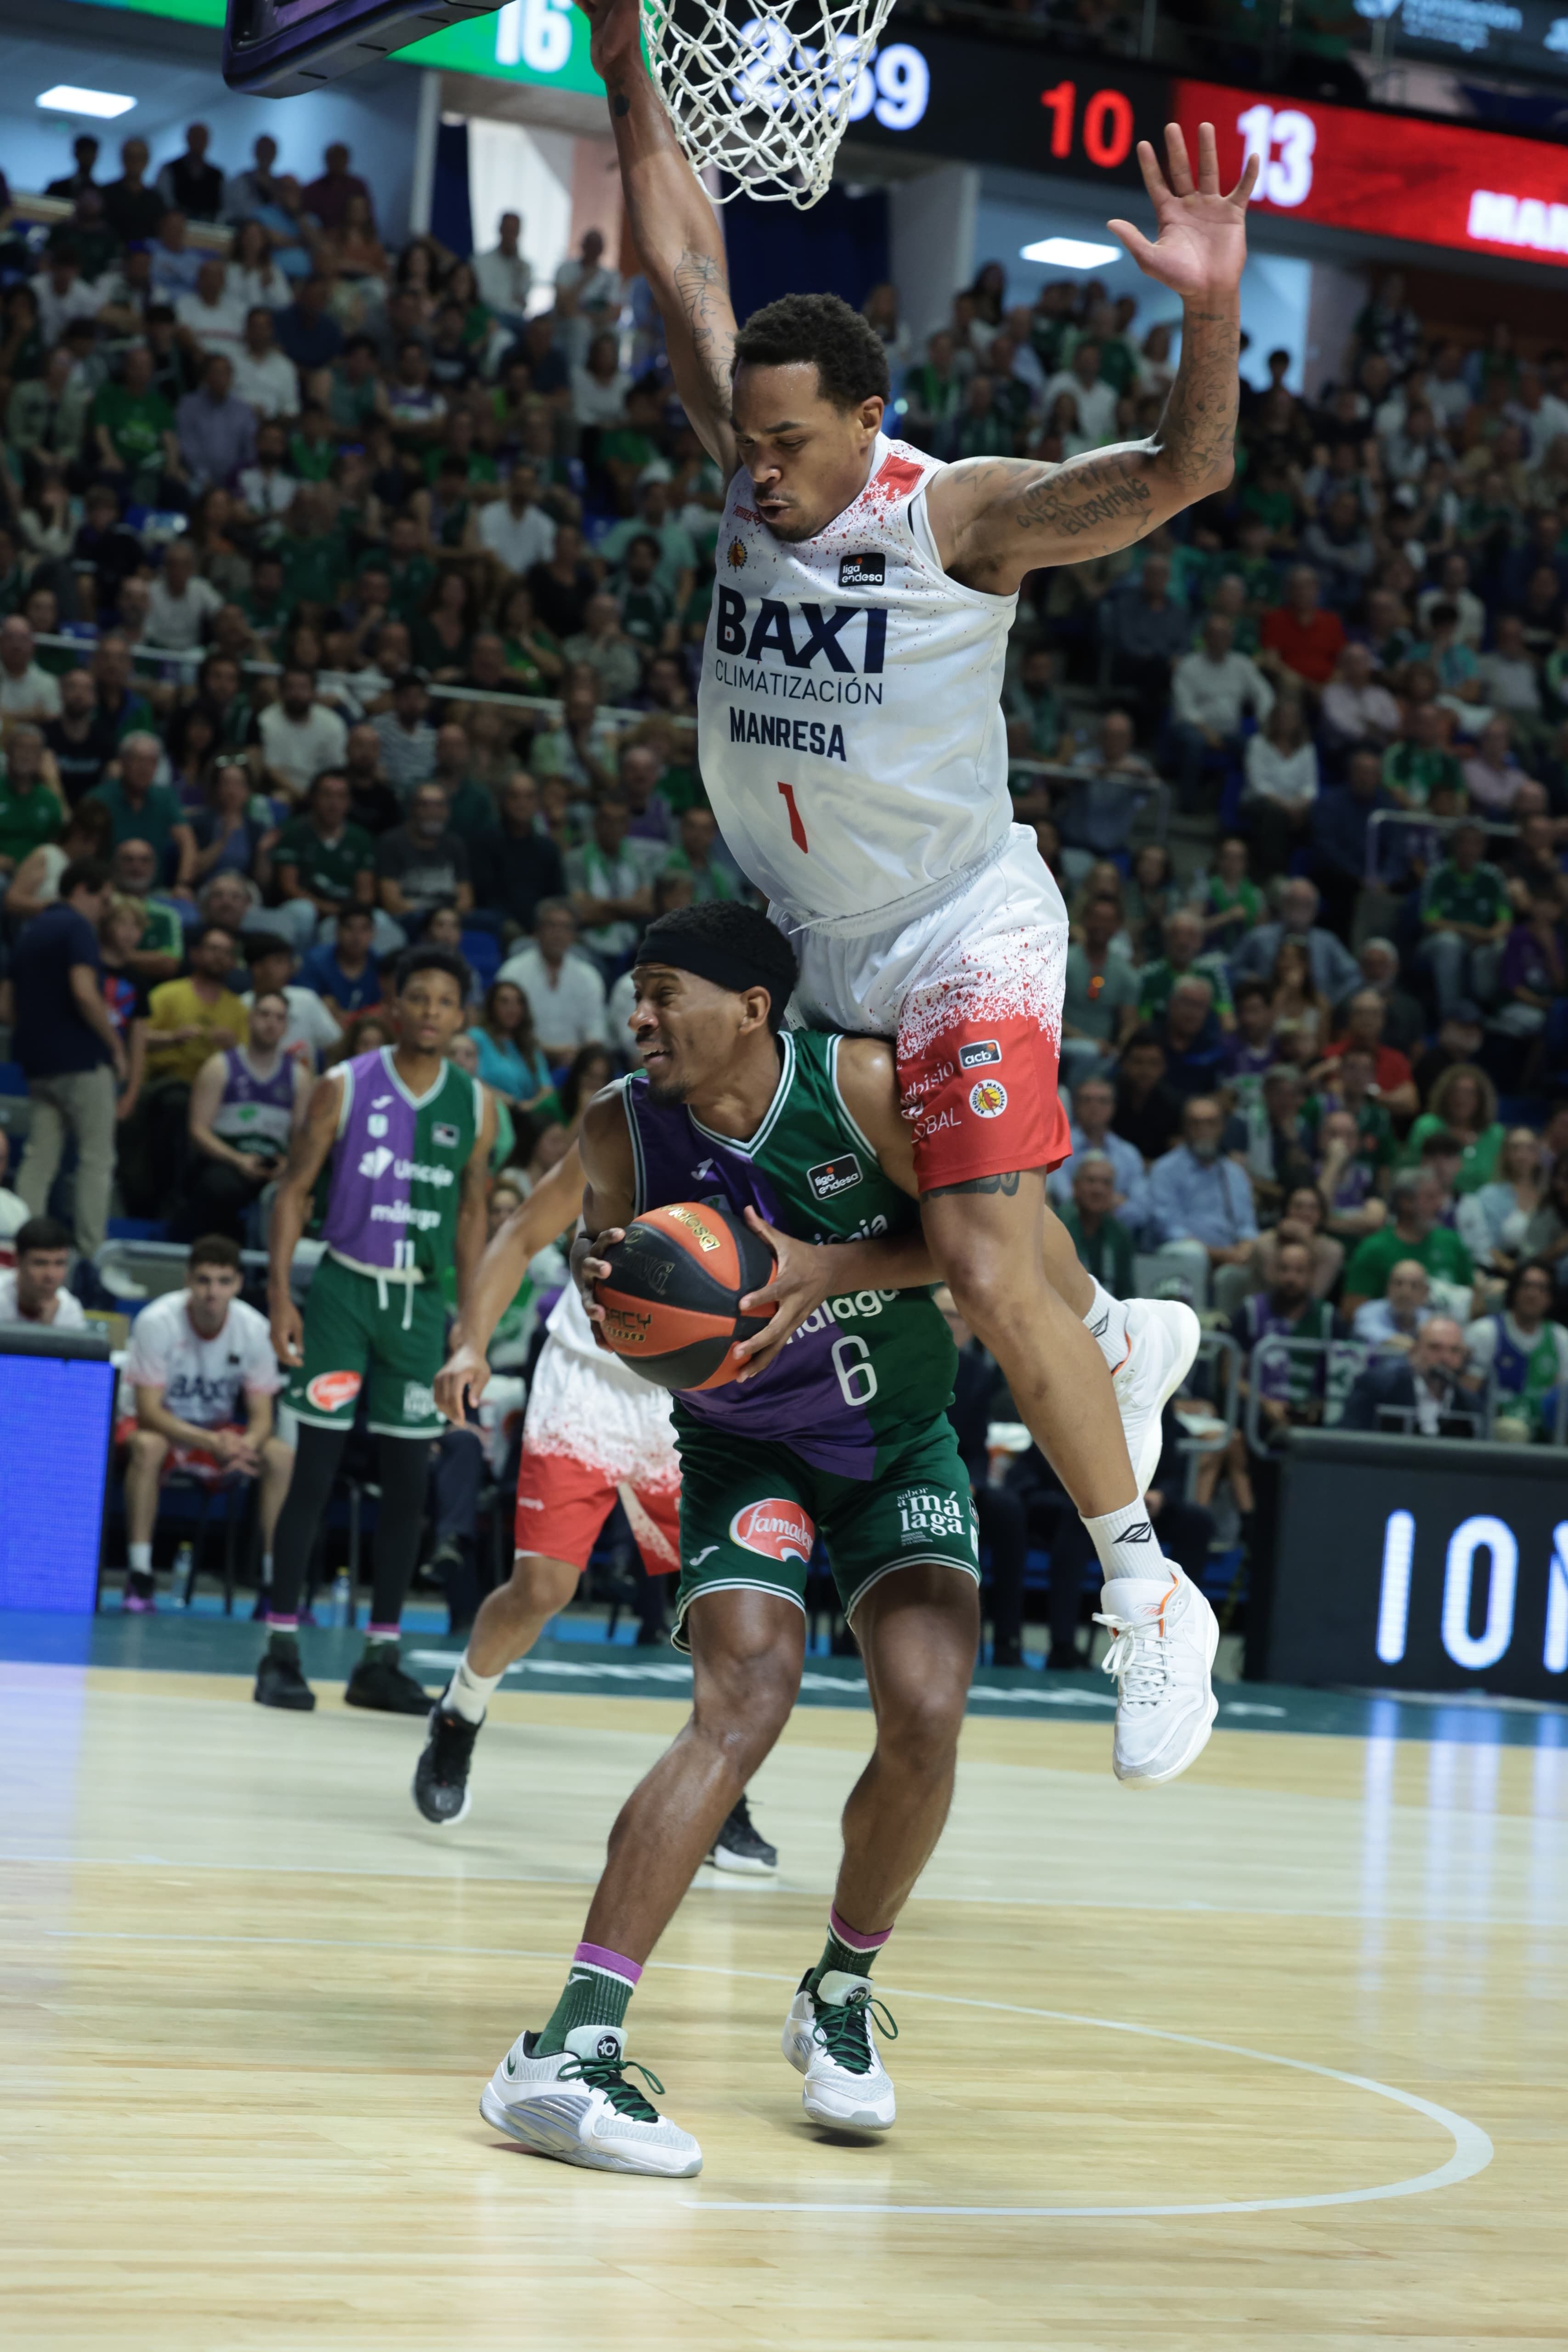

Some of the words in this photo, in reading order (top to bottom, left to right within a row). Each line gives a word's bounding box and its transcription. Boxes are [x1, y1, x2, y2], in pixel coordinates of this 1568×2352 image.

[494, 0, 573, 73] 16
[1041, 80, 1134, 168] 10
[1237, 104, 1317, 208] 13
[842, 572, 883, 583] endesa
[843, 565, 860, 575] liga
[717, 583, 888, 673] BAXI
[715, 660, 883, 705] CLIMATIZACIÓN
[730, 706, 847, 762] MANRESA
[777, 781, 808, 854] 1
[965, 1051, 991, 1064] acb
[815, 1174, 835, 1186] liga
[819, 1173, 859, 1194] endesa
[831, 1335, 878, 1406] 6
[897, 1487, 928, 1499] sabor
[908, 1491, 964, 1518] má
[900, 1509, 966, 1536] laga
